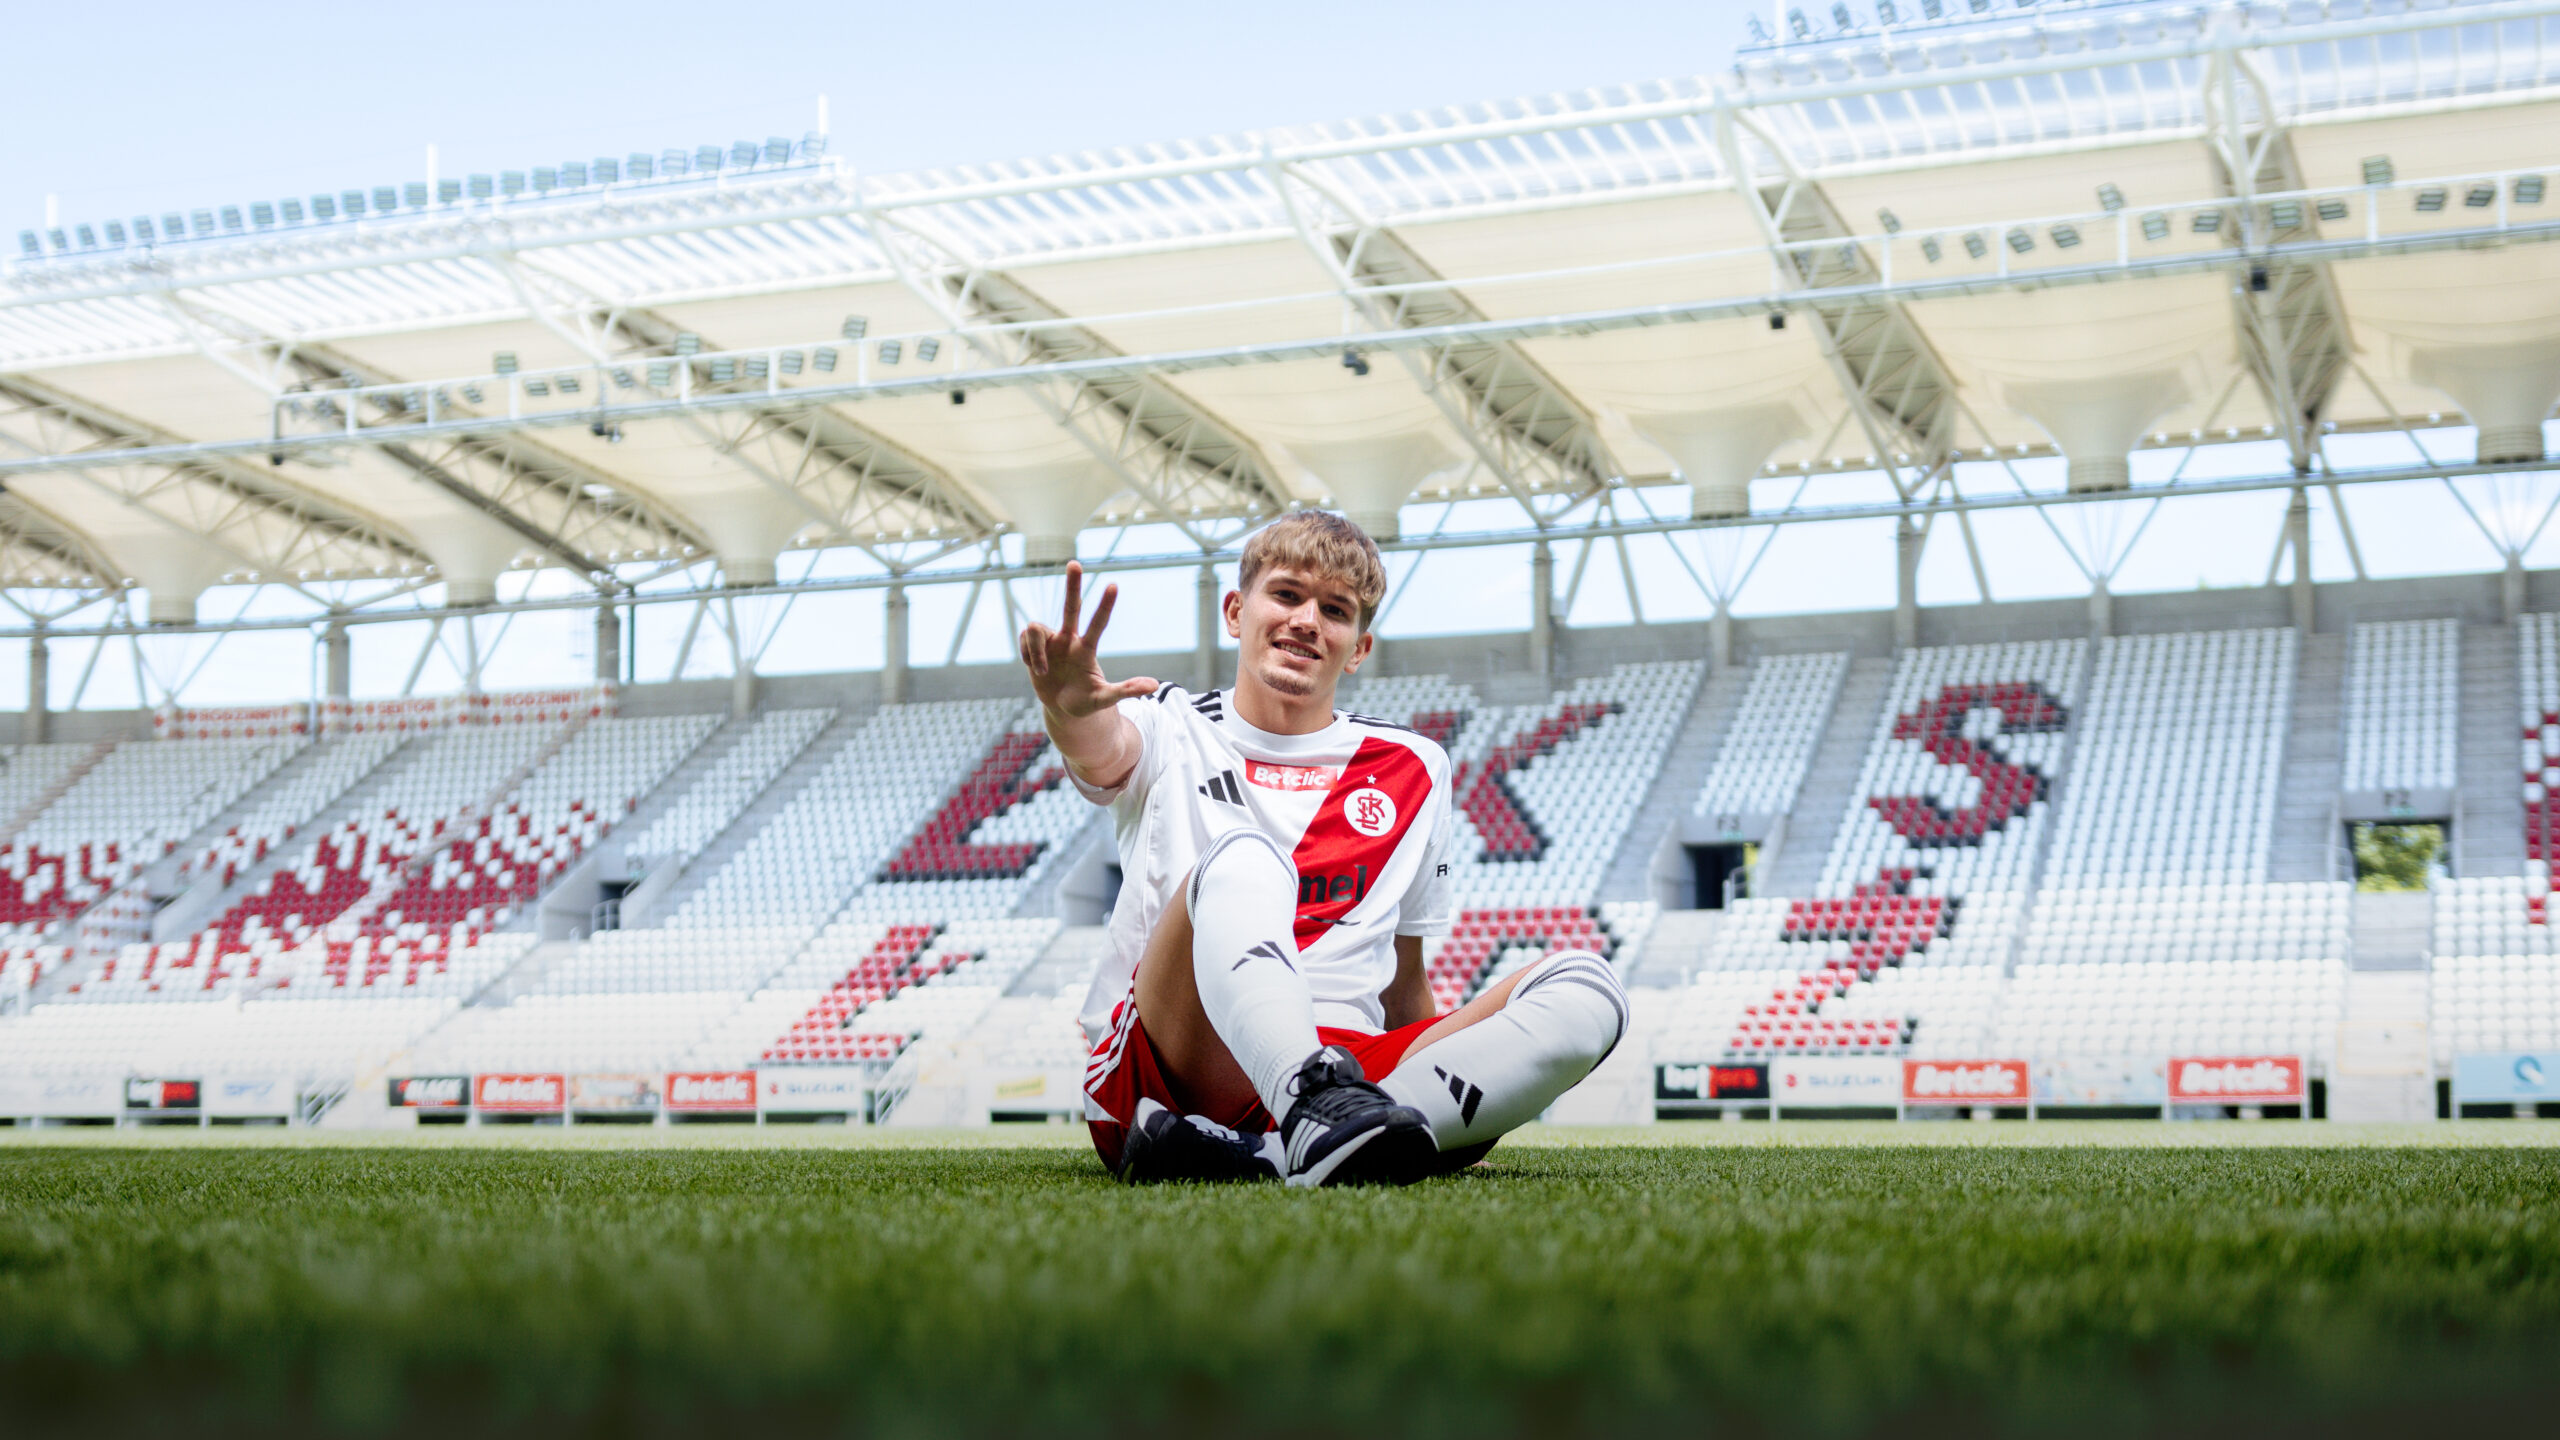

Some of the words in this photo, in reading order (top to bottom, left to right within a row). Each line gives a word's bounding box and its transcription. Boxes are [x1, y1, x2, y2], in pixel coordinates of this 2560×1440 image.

[1253, 766, 1327, 786] Betclic
[1436, 863, 1451, 878] R
[1299, 864, 1368, 903] mel
[1914, 1063, 2017, 1094] Betclic
